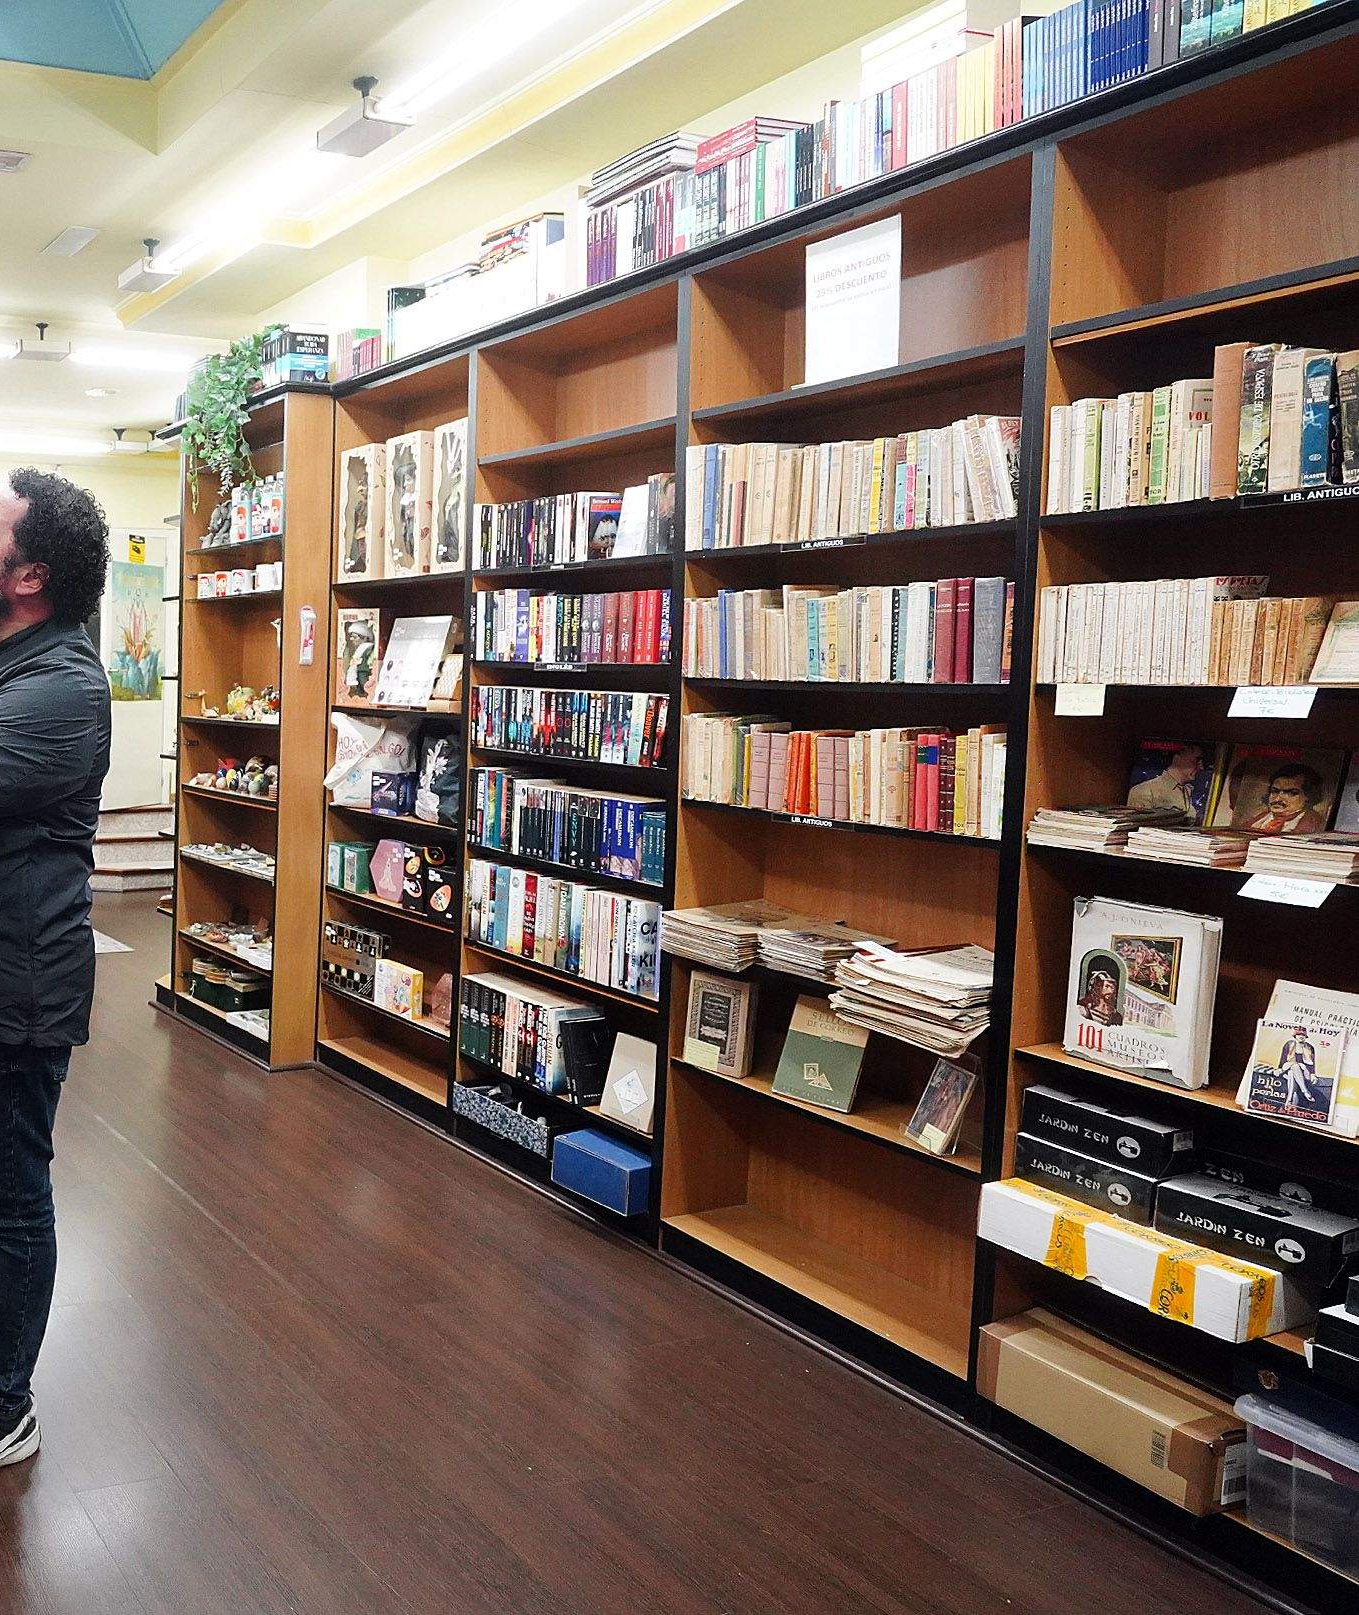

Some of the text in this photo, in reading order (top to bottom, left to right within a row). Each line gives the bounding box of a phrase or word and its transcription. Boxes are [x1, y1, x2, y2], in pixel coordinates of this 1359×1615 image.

[1255, 368, 1266, 400] ESPAÑA
[1283, 486, 1359, 502] LIB. ANTIGUO
[643, 711, 654, 739] Deaver
[802, 818, 833, 827] ANTIGUOS
[557, 892, 568, 940] DAN BROWN
[1292, 1005, 1323, 1019] MANUAL
[1294, 1015, 1304, 1024] DE
[1261, 1020, 1274, 1028] La
[1275, 1022, 1306, 1033] Novela
[1319, 1028, 1341, 1038] Hoy
[1077, 1023, 1166, 1054] 101 CUADROS
[1251, 1087, 1286, 1099] perlas
[1285, 1106, 1328, 1121] Pinedo
[1083, 1128, 1109, 1144] ZEN
[1075, 1174, 1101, 1190] ZEN
[1232, 1228, 1266, 1247] ZEN
